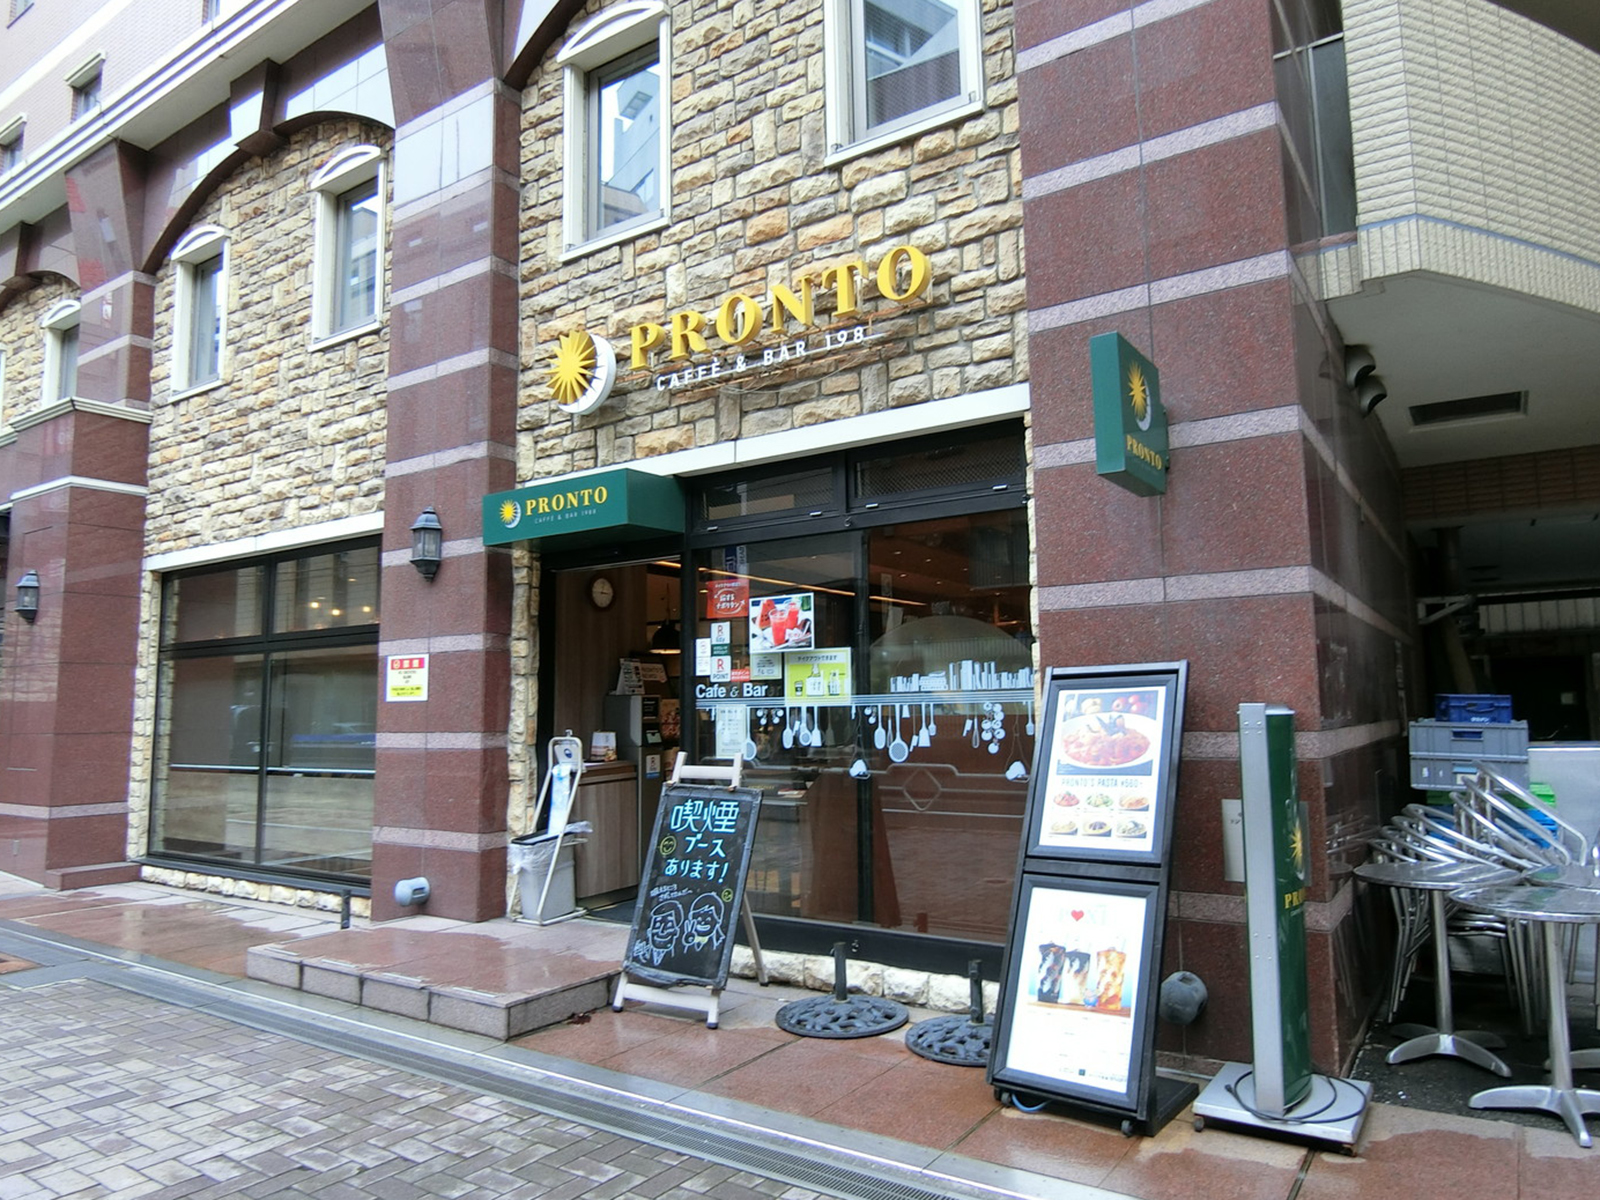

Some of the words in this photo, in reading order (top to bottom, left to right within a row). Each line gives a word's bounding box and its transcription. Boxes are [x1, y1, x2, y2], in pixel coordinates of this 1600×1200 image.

[628, 245, 932, 371] PRONTO
[656, 358, 721, 391] CAFFÈ
[736, 356, 747, 372] &
[763, 341, 806, 366] BAR
[1126, 434, 1162, 470] PRONTO
[525, 486, 607, 515] PRONTO
[695, 683, 727, 698] Cafe
[730, 686, 739, 697] &
[743, 682, 768, 697] Bar
[670, 799, 740, 833] 喫煙
[685, 833, 726, 858] ブース
